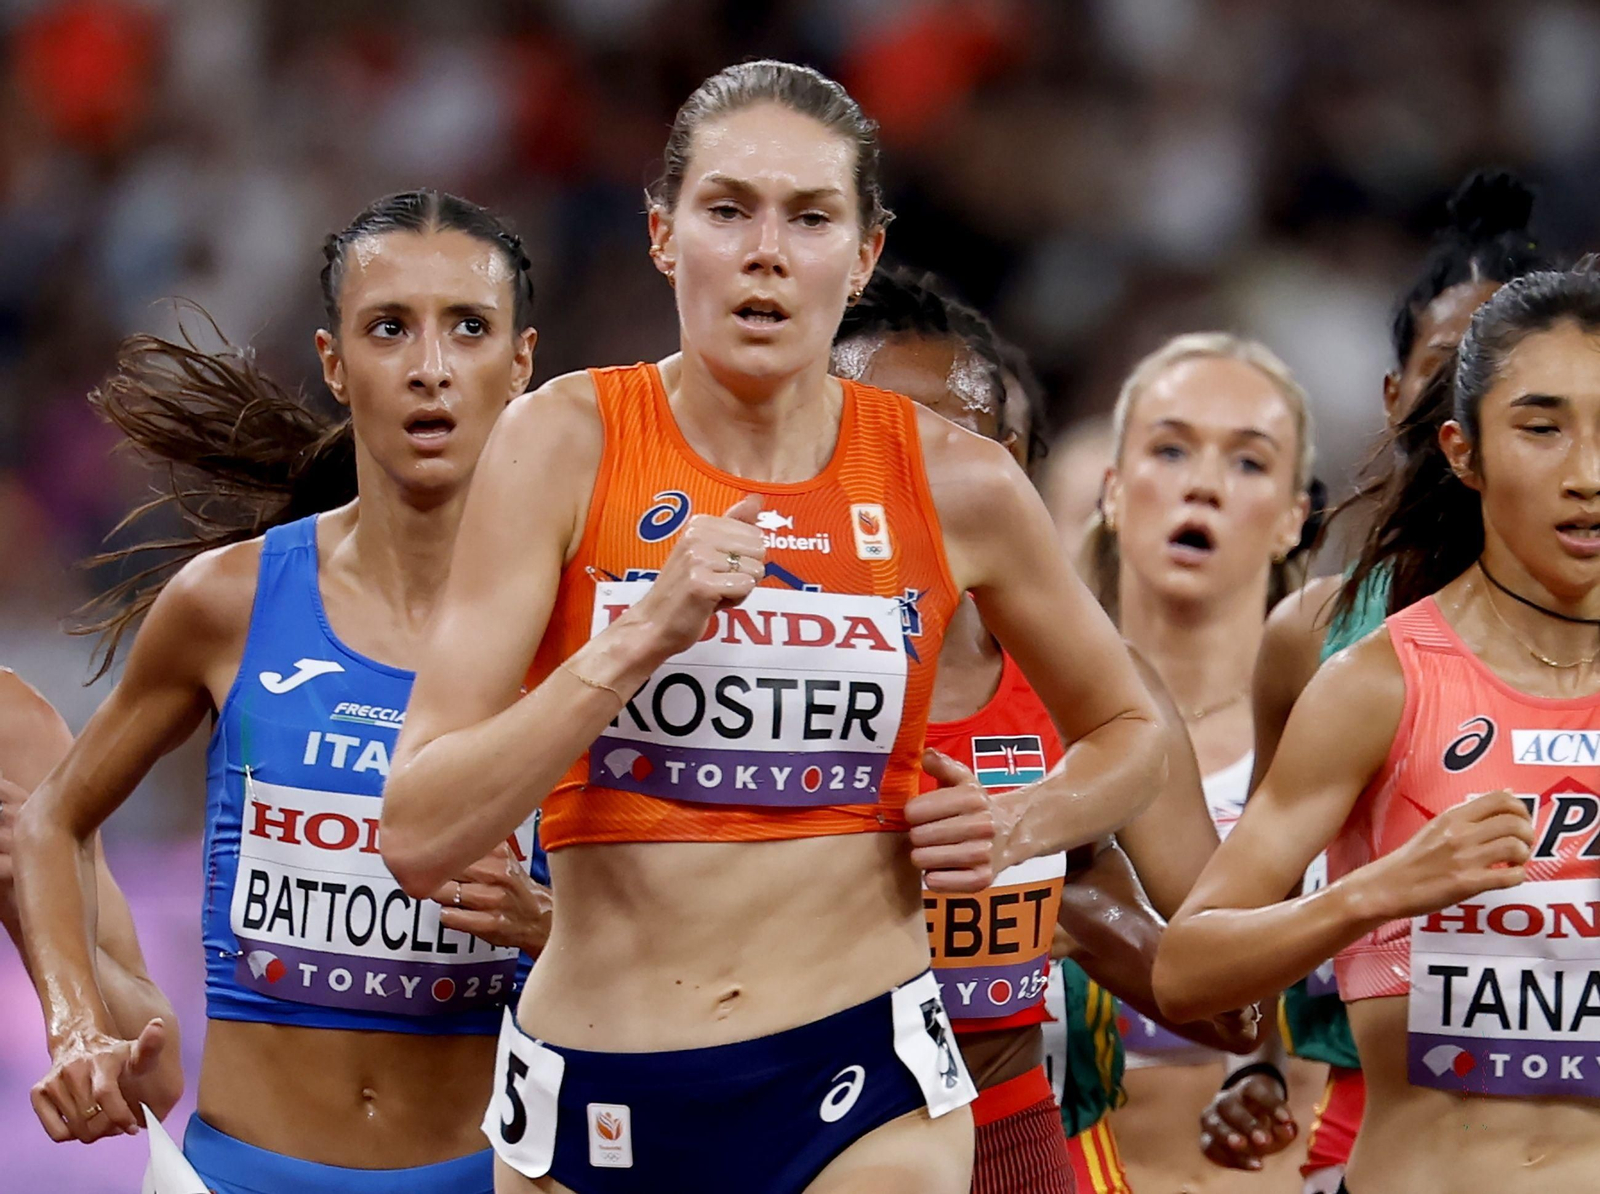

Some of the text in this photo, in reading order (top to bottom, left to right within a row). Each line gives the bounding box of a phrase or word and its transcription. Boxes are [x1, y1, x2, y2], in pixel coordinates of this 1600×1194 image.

[303, 731, 390, 776] ITA
[1517, 732, 1600, 763] ACN
[241, 869, 510, 955] BATTOCL
[1420, 901, 1600, 938] HON
[1428, 965, 1600, 1032] TANA
[1489, 1053, 1600, 1080] TOK
[500, 1049, 530, 1145] 5
